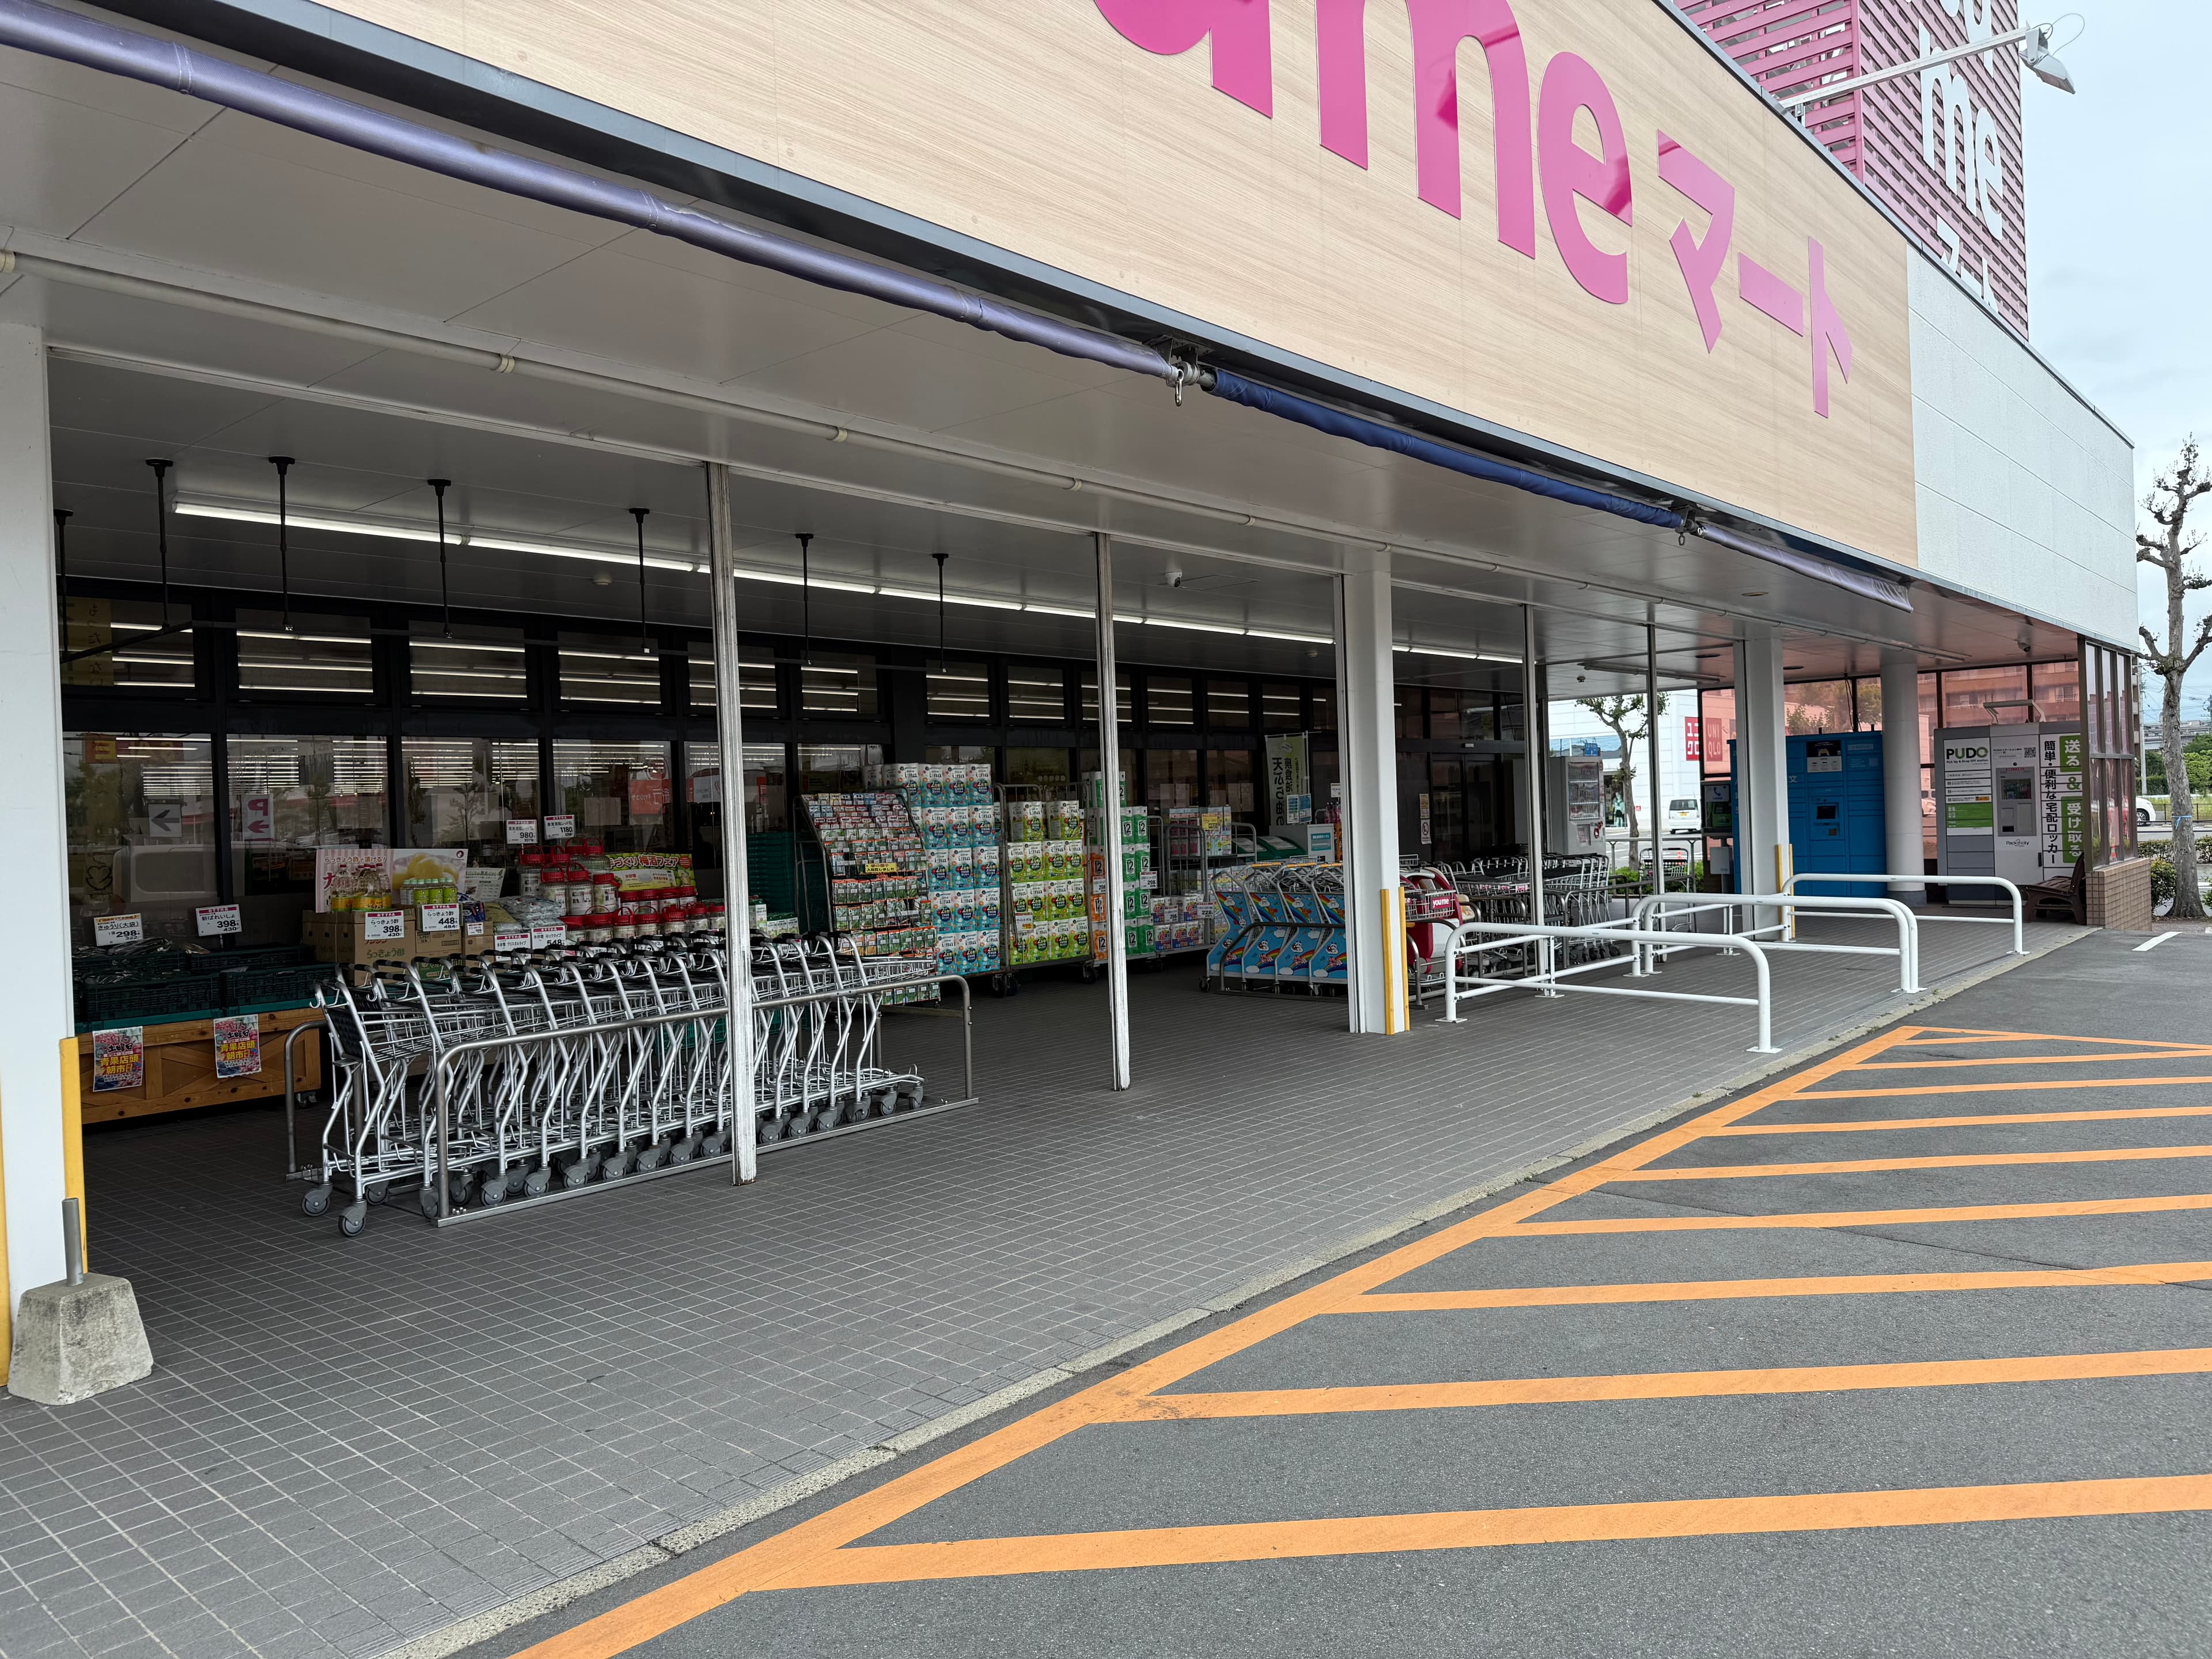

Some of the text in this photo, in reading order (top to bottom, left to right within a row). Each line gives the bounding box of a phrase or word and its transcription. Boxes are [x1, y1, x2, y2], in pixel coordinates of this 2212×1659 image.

[1707, 724, 1719, 738] UNI
[1708, 741, 1721, 757] QLO
[1946, 747, 1988, 759] PUDO
[2044, 740, 2058, 863] 簡単・便利な宅配ロッカー
[2065, 740, 2082, 857] 送る & 受け取る
[1124, 824, 1131, 833] 12
[1139, 823, 1145, 832] 12
[1094, 862, 1102, 873] 12
[1127, 860, 1134, 872] 12
[1142, 858, 1148, 869] 12
[1128, 898, 1134, 908] 12
[1141, 895, 1147, 905] 12
[1433, 899, 1449, 908] youme
[217, 920, 236, 928] 398
[383, 925, 399, 933] 398
[1129, 934, 1136, 944] 12
[1147, 932, 1152, 942] 12
[1099, 938, 1105, 948] 12
[366, 948, 406, 959] らっきょう酢
[221, 1040, 256, 1052] 青果店頭
[101, 1054, 139, 1066] 青果店頭
